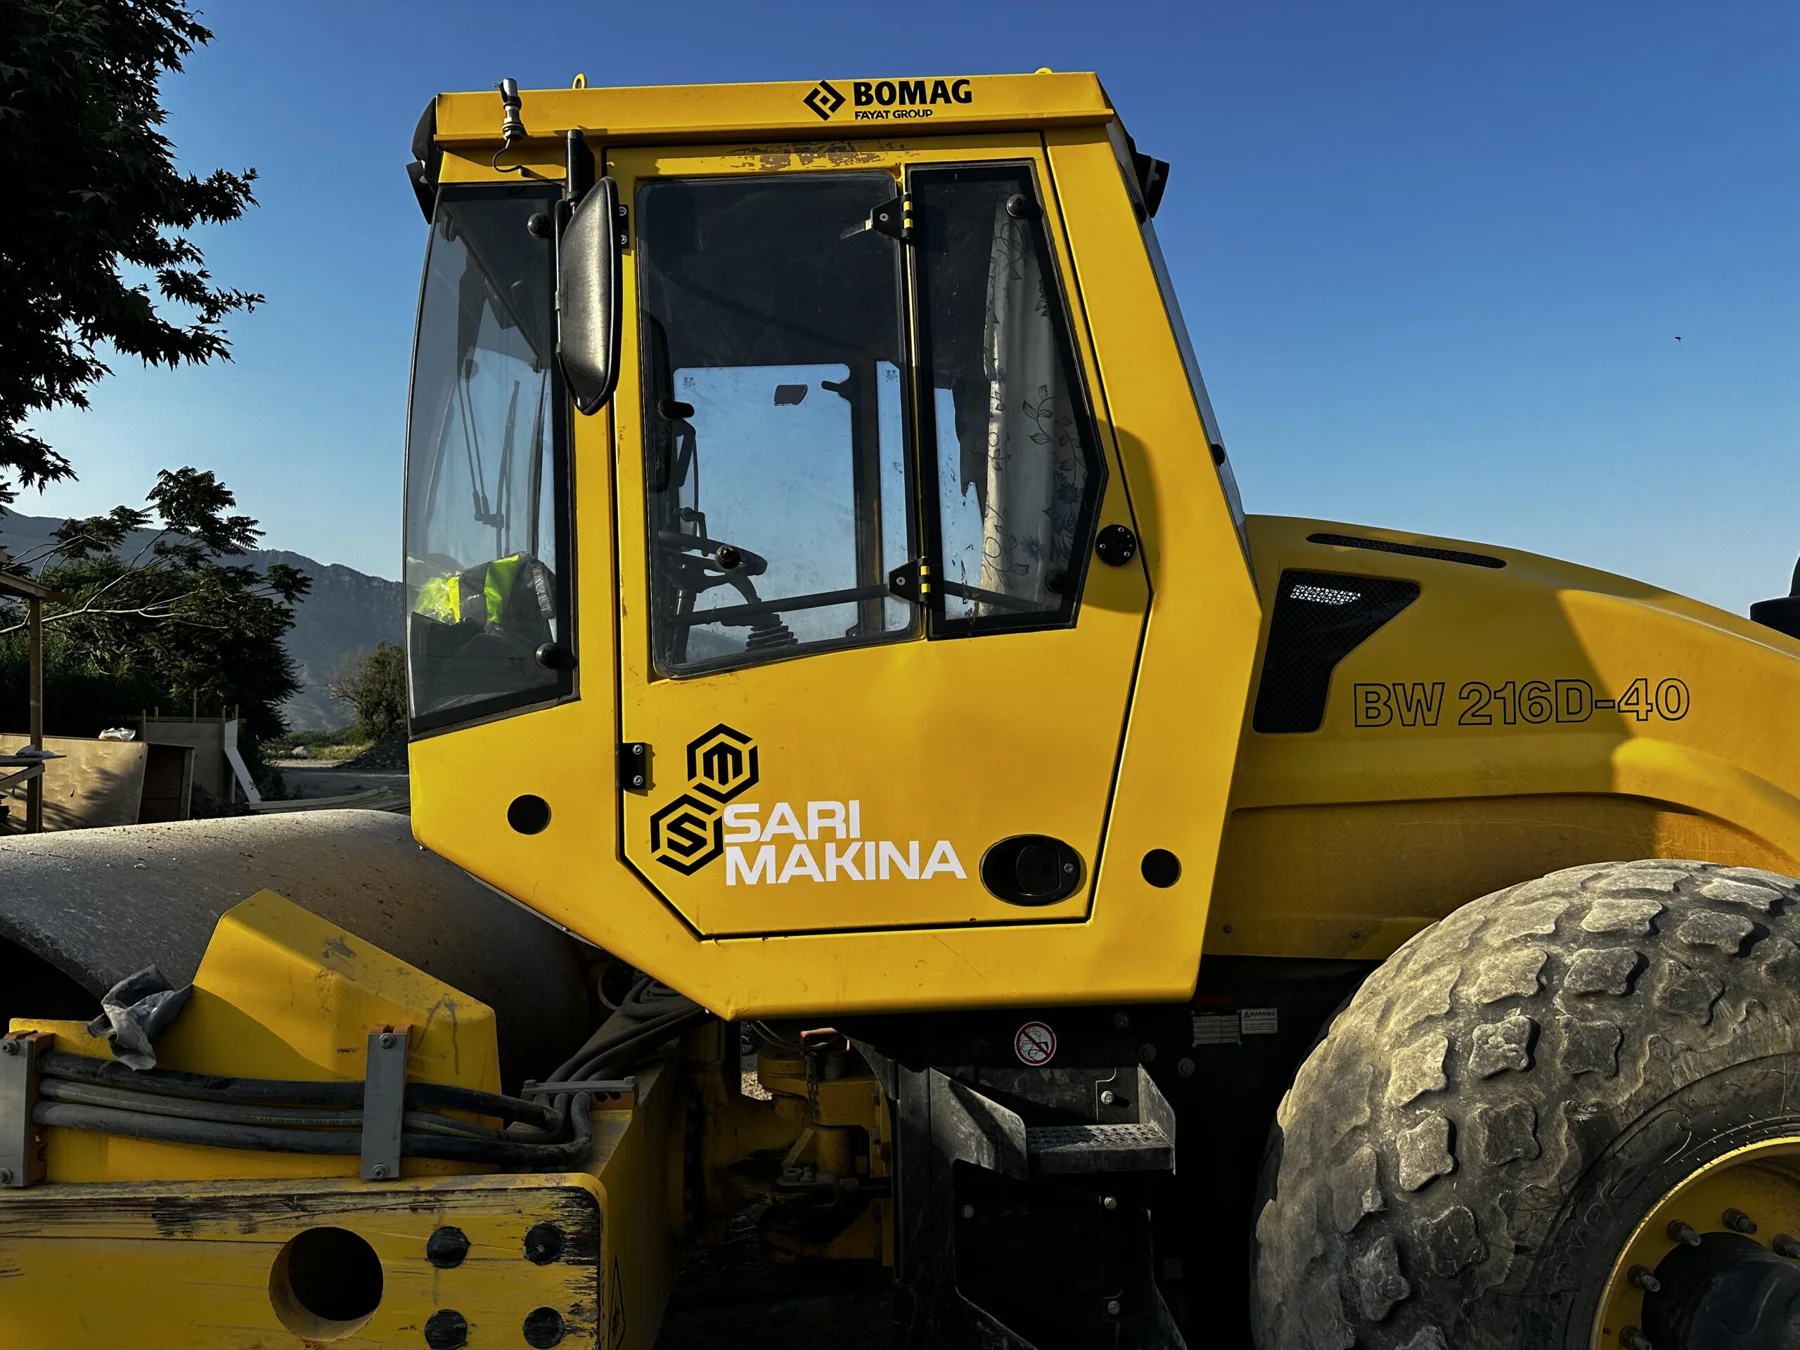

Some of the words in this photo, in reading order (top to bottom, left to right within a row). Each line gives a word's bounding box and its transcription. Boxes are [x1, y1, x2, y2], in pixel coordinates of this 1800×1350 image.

[853, 79, 972, 106] BOMAG
[854, 110, 890, 120] FAYAT
[893, 109, 933, 118] GROUP
[1353, 682, 1445, 727] BW
[1458, 677, 1690, 725] 216D-40
[723, 800, 861, 844] SARI
[725, 840, 968, 886] MAKINA
